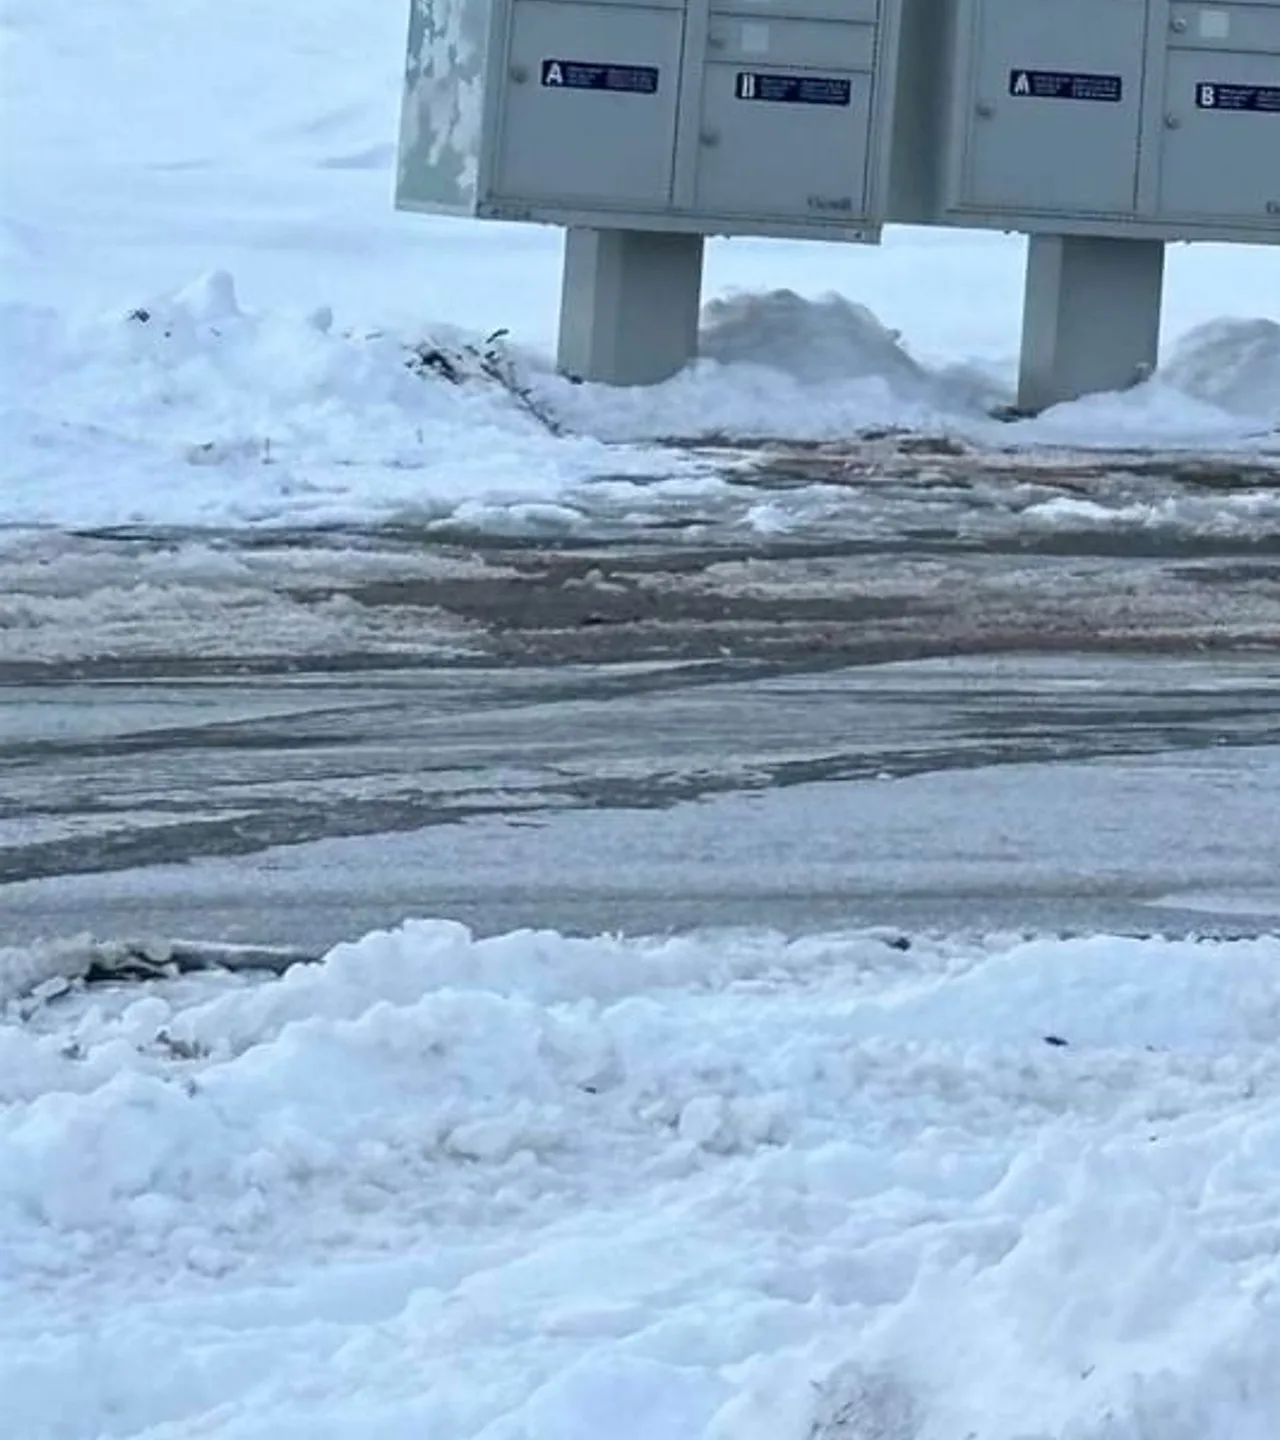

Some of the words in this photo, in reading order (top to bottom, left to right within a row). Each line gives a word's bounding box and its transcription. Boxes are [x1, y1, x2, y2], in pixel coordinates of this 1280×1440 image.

[544, 62, 565, 85] A
[1014, 72, 1031, 95] A
[1201, 86, 1215, 107] B
